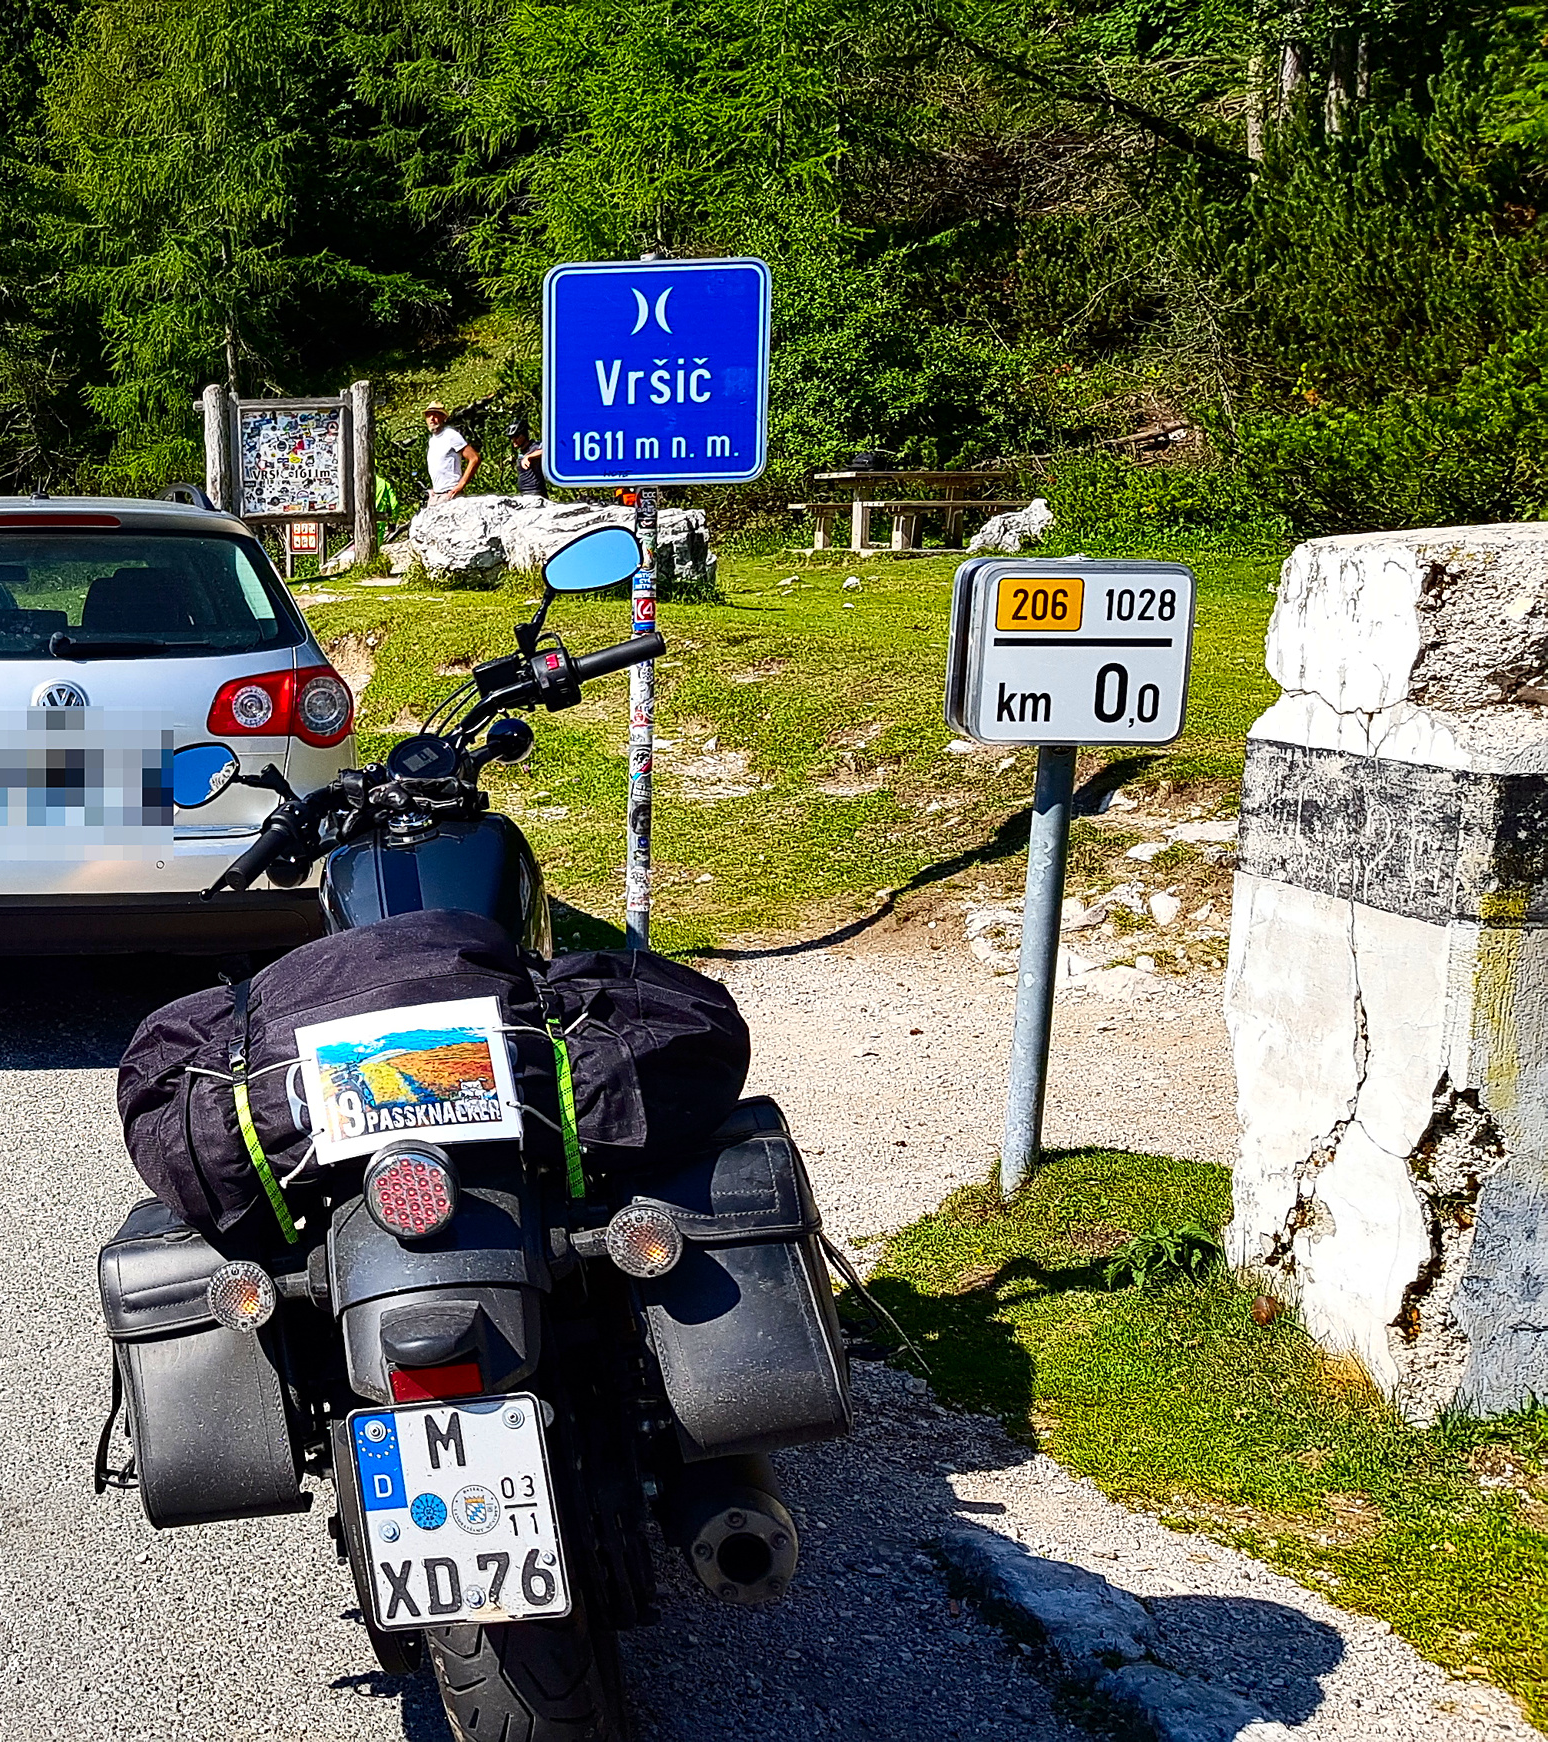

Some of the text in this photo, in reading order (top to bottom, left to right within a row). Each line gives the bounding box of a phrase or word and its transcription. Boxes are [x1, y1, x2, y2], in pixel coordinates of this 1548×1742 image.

[595, 358, 711, 406] Vršič
[572, 431, 739, 461] 1611 m n. m.
[1012, 588, 1176, 622] 206 1028
[997, 663, 1160, 728] km 0,0
[366, 1099, 503, 1133] PASSKNACKER
[424, 1412, 466, 1470] M
[374, 1474, 392, 1498] D
[500, 1475, 535, 1498] 03
[509, 1512, 540, 1536] 11
